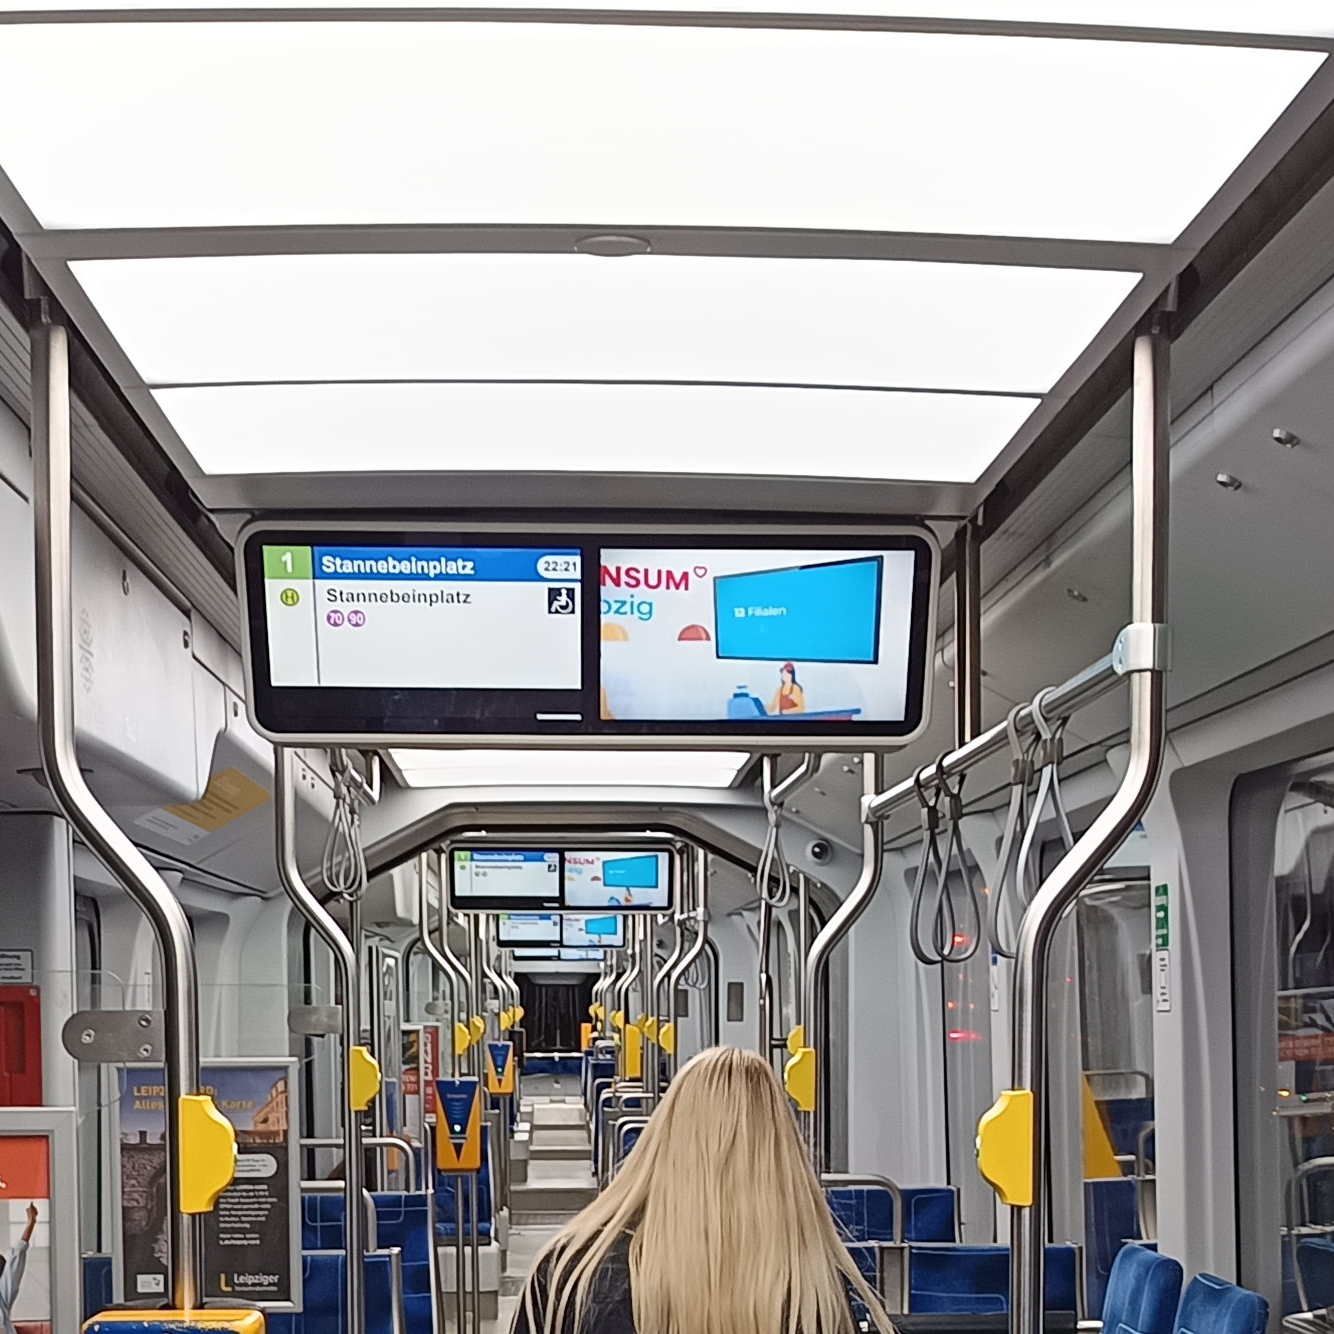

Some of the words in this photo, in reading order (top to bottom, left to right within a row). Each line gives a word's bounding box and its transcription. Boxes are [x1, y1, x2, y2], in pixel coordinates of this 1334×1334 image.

[280, 551, 293, 573] 1
[322, 555, 475, 578] Stannebeinplatz
[543, 560, 578, 573] 22:21
[601, 565, 690, 591] NSUM
[326, 588, 472, 607] Stannebeinplatz
[328, 612, 343, 625] 70
[348, 612, 365, 625] 90
[221, 1099, 254, 1110] Karte
[234, 1272, 279, 1285] Leipziger
